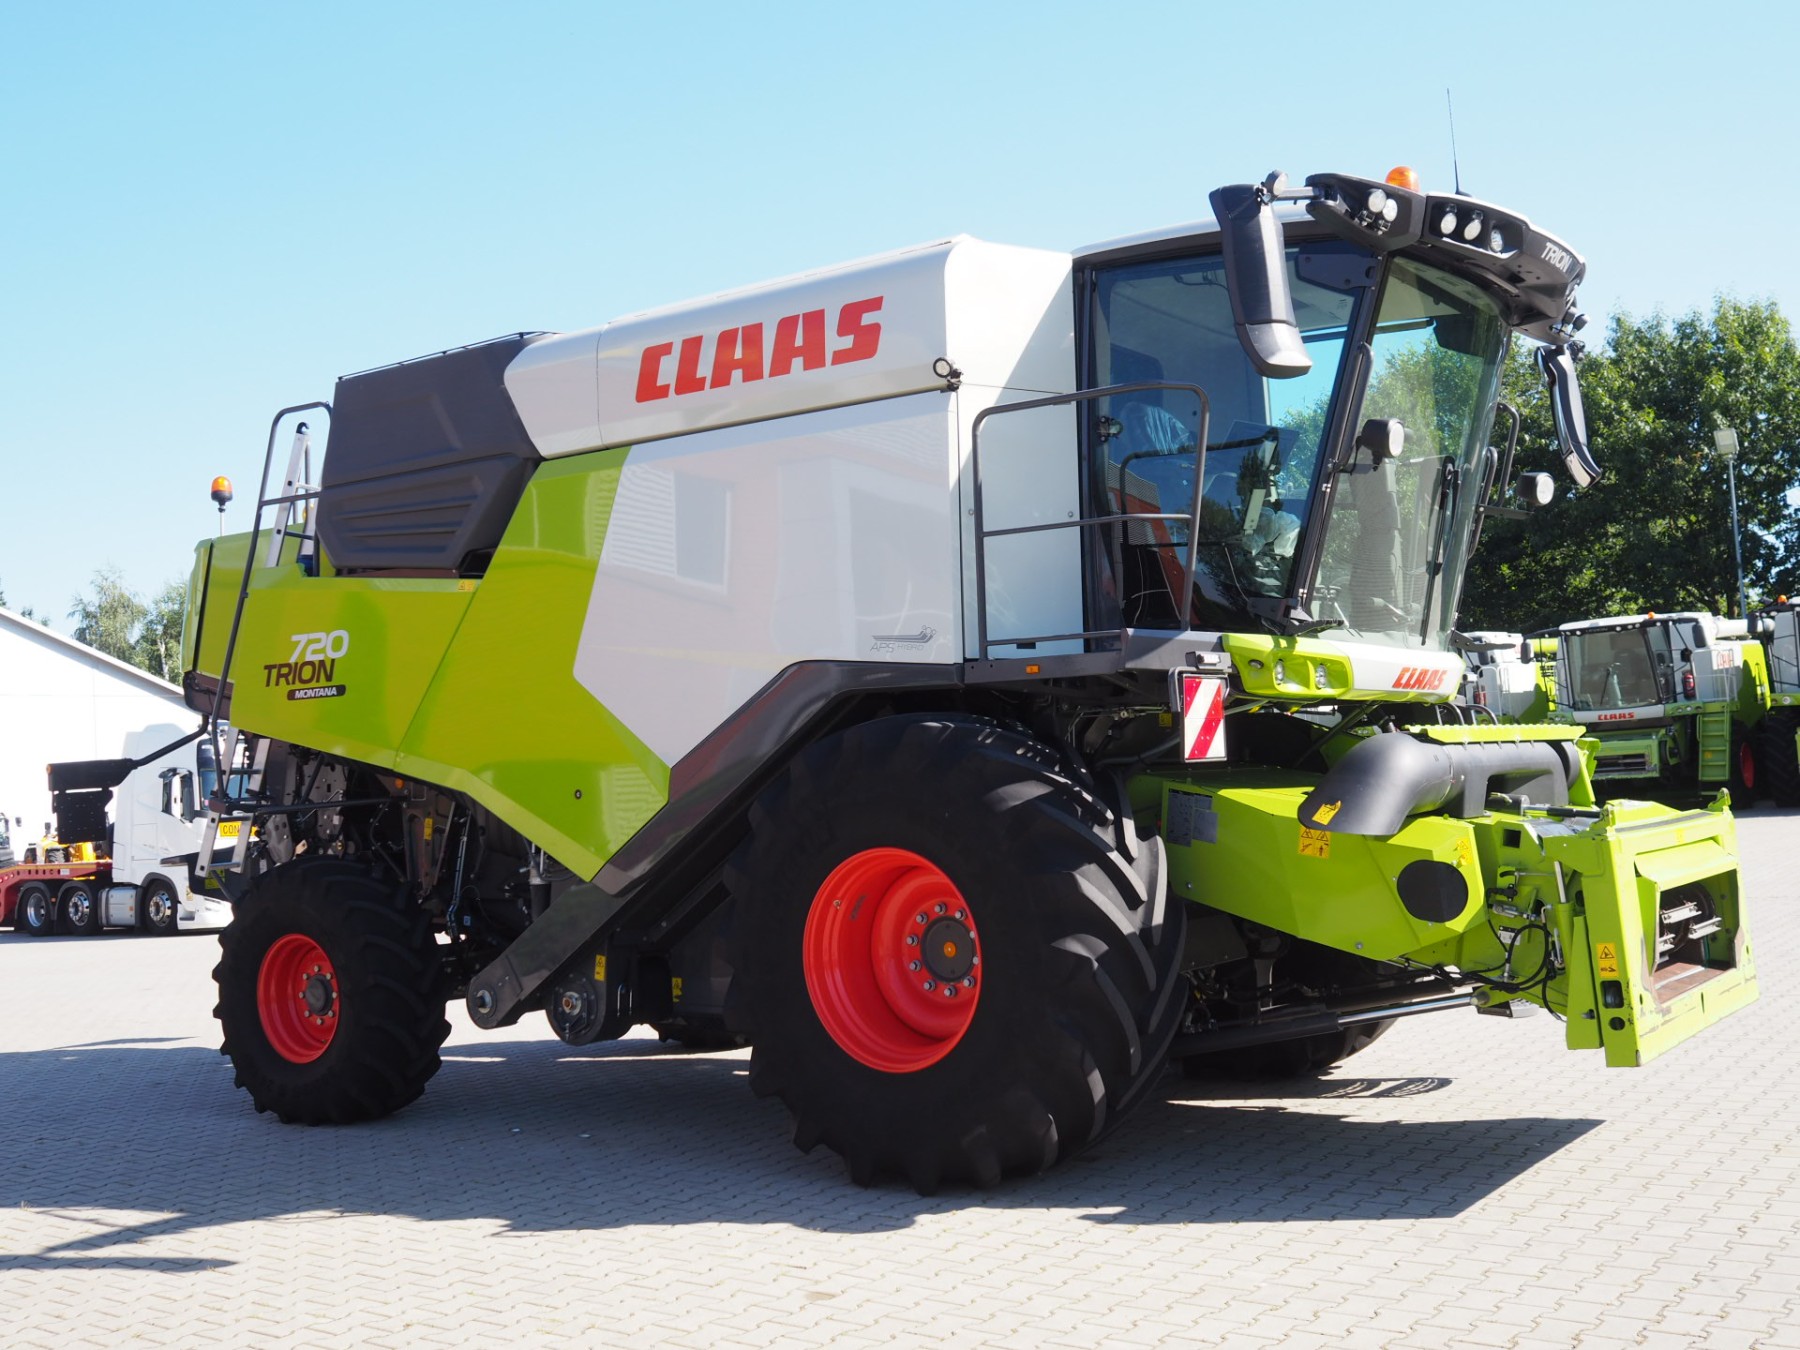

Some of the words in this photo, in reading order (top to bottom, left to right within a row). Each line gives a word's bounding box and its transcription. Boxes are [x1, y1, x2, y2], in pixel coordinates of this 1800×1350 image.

[1541, 241, 1573, 273] TRION
[635, 295, 884, 404] CLAAS
[289, 629, 350, 663] 720
[870, 642, 895, 653] APS
[263, 658, 336, 688] TRION
[1391, 666, 1448, 691] CLAAS
[294, 686, 338, 699] MONTANA
[1597, 711, 1635, 720] CLAAS
